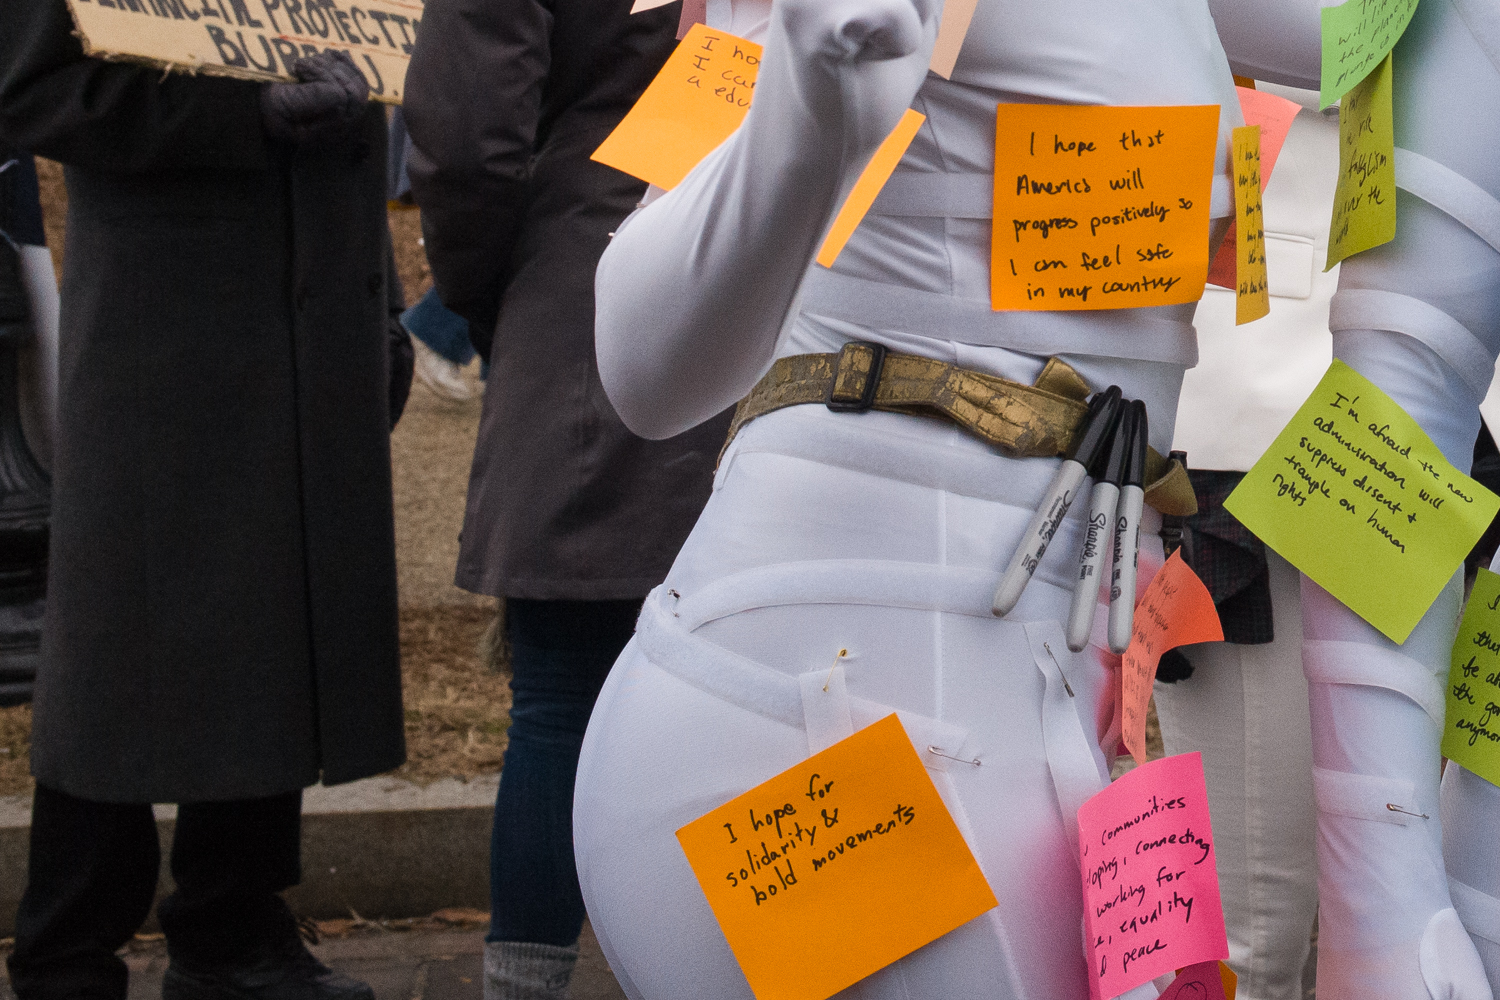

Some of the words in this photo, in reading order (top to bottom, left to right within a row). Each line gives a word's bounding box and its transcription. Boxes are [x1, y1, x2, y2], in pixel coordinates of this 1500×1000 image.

[693, 55, 710, 71] I
[701, 36, 720, 51] I
[732, 45, 760, 71] ho
[1029, 131, 1036, 156] I
[1054, 134, 1097, 157] hope
[1120, 129, 1165, 151] that
[1016, 174, 1092, 196] America
[1109, 168, 1144, 191] will
[1012, 218, 1078, 242] progress
[1090, 200, 1170, 236] positively
[1009, 258, 1018, 276] I
[1034, 258, 1067, 273] can
[1081, 244, 1121, 271] feel
[1136, 243, 1174, 262] safe
[1026, 283, 1045, 300] in
[1059, 284, 1092, 301] my
[1102, 275, 1182, 294] country
[1299, 436, 1347, 477] suppress
[1313, 417, 1406, 490] administration
[1418, 489, 1445, 509] will
[1329, 391, 1360, 423] I'm
[1368, 424, 1412, 459] afraid
[1417, 459, 1440, 481] the
[1447, 482, 1474, 503] new
[1272, 473, 1307, 507] rights
[1284, 455, 1331, 498] trample
[1339, 498, 1356, 515] on
[1367, 508, 1406, 554] human
[1462, 655, 1479, 678] be
[1453, 683, 1475, 705] the
[723, 822, 738, 844] I
[749, 802, 797, 838] hope
[805, 773, 834, 801] for
[1101, 795, 1187, 846] communities
[725, 820, 817, 887] solidarity
[821, 807, 839, 828] &
[750, 858, 798, 906] bold
[811, 803, 915, 872] movements
[1135, 827, 1211, 865] connecting
[1097, 884, 1146, 917] working
[1156, 866, 1186, 888] for
[1120, 891, 1194, 933] equality
[1123, 938, 1168, 973] peace
